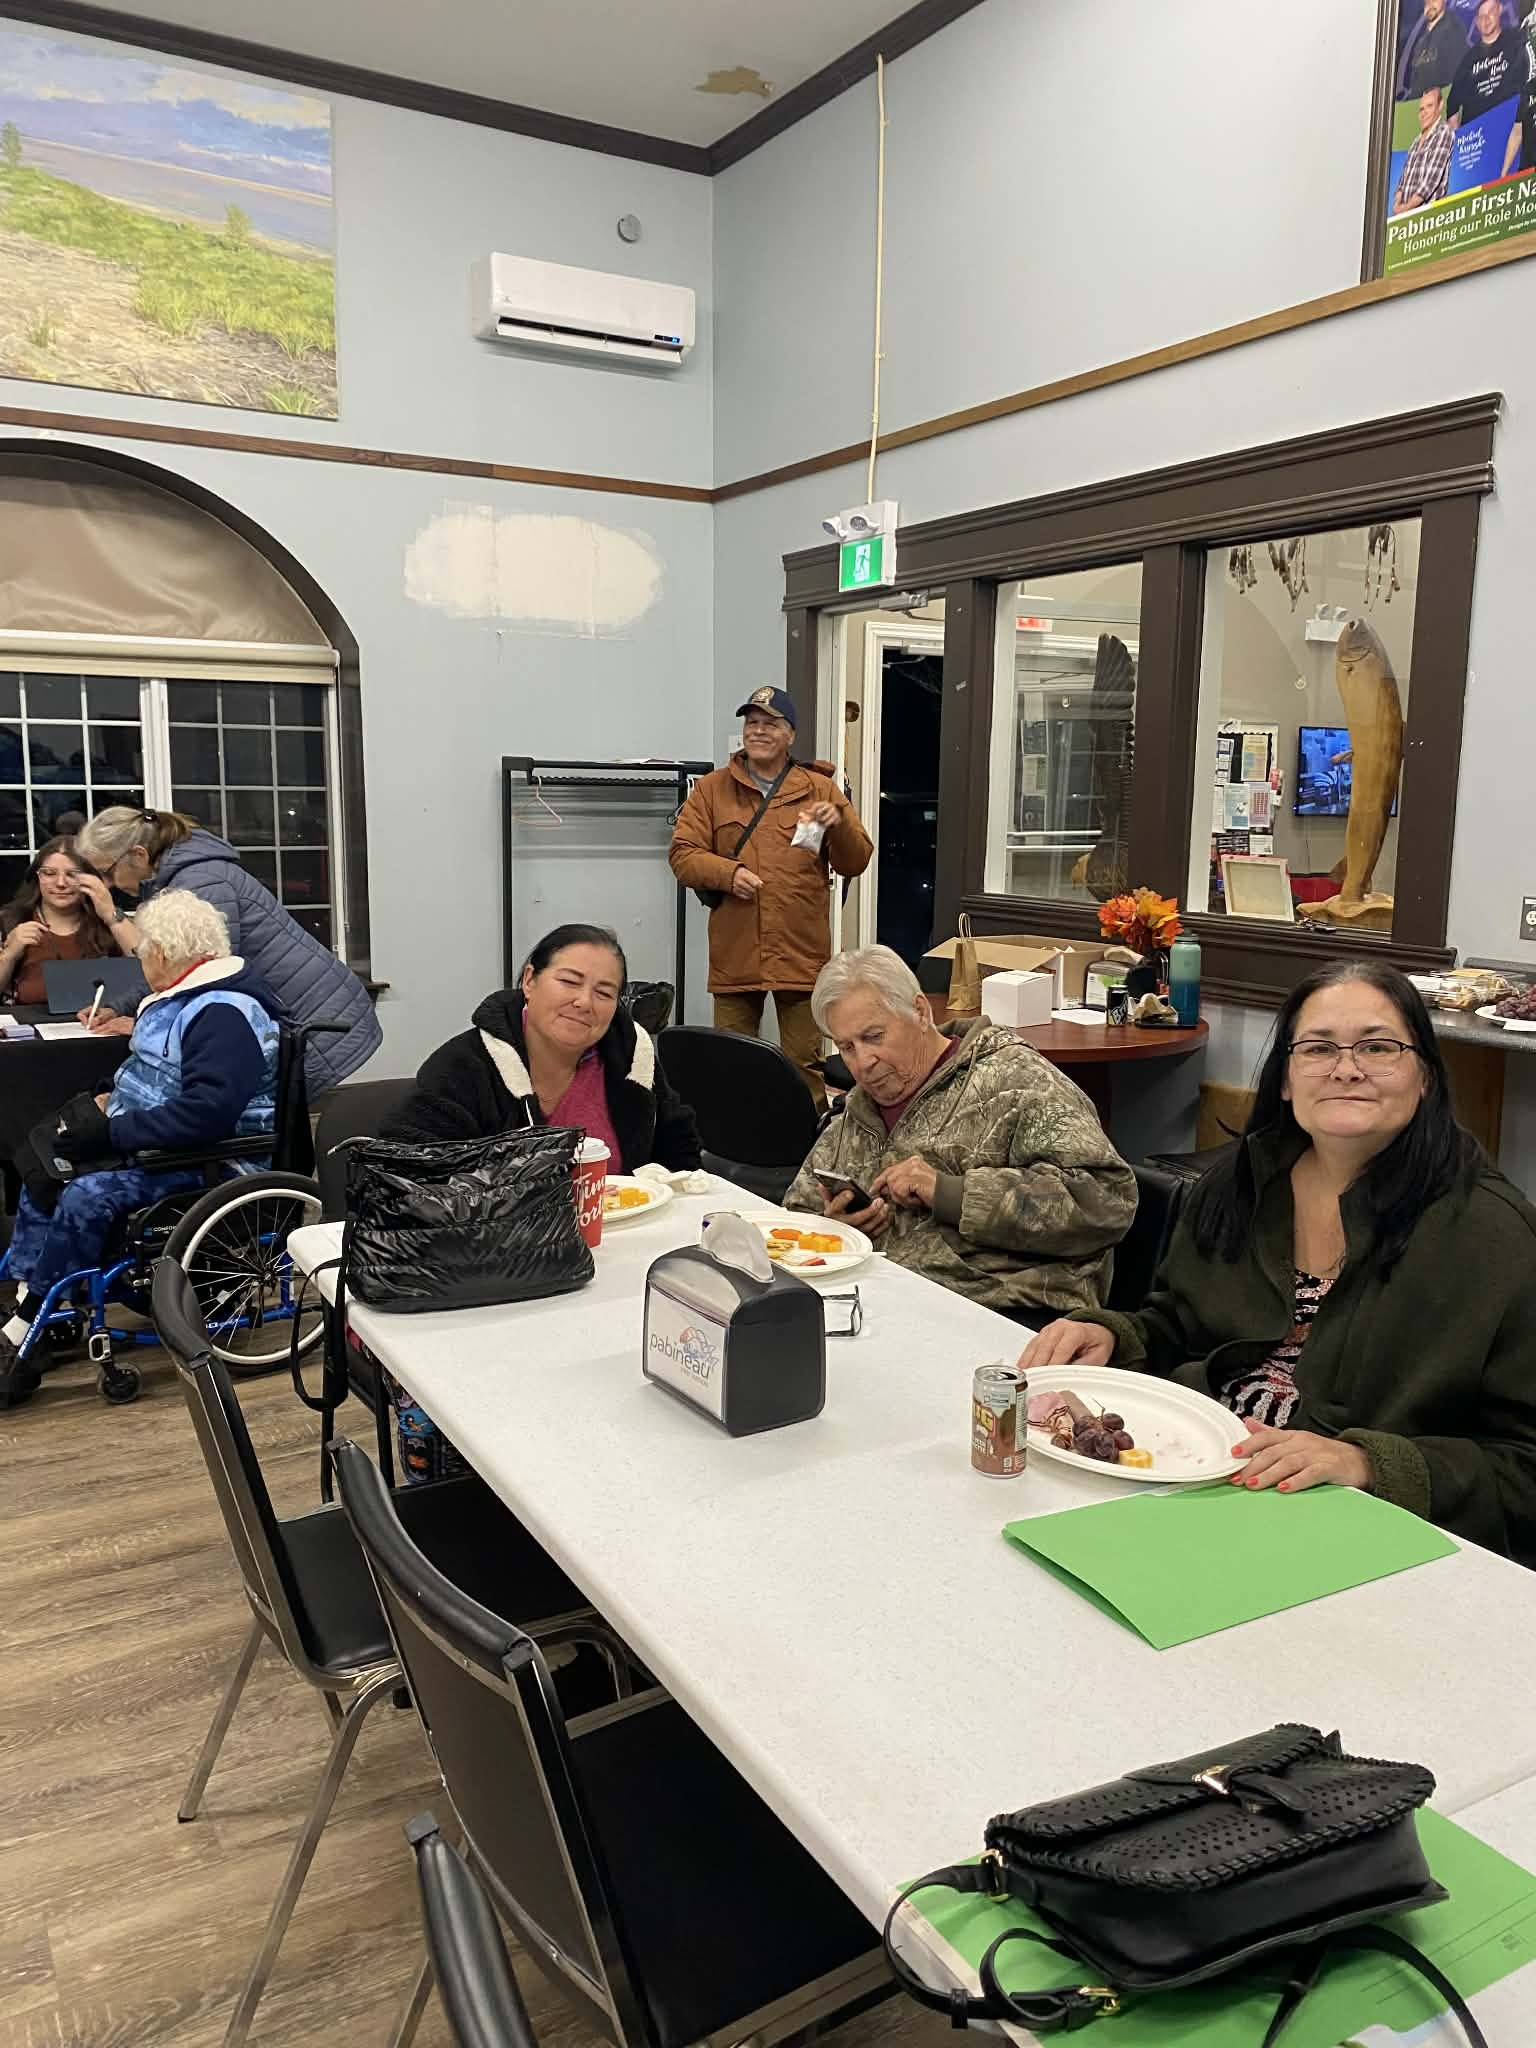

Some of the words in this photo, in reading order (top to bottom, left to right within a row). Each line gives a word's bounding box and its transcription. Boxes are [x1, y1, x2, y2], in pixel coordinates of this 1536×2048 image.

[1388, 206, 1466, 244] Pabineau
[1471, 187, 1514, 216] First
[1403, 227, 1458, 255] Honoring
[1460, 219, 1482, 235] our
[1484, 209, 1511, 228] Role
[1515, 201, 1536, 217] Mo
[649, 1334, 710, 1380] pabineau
